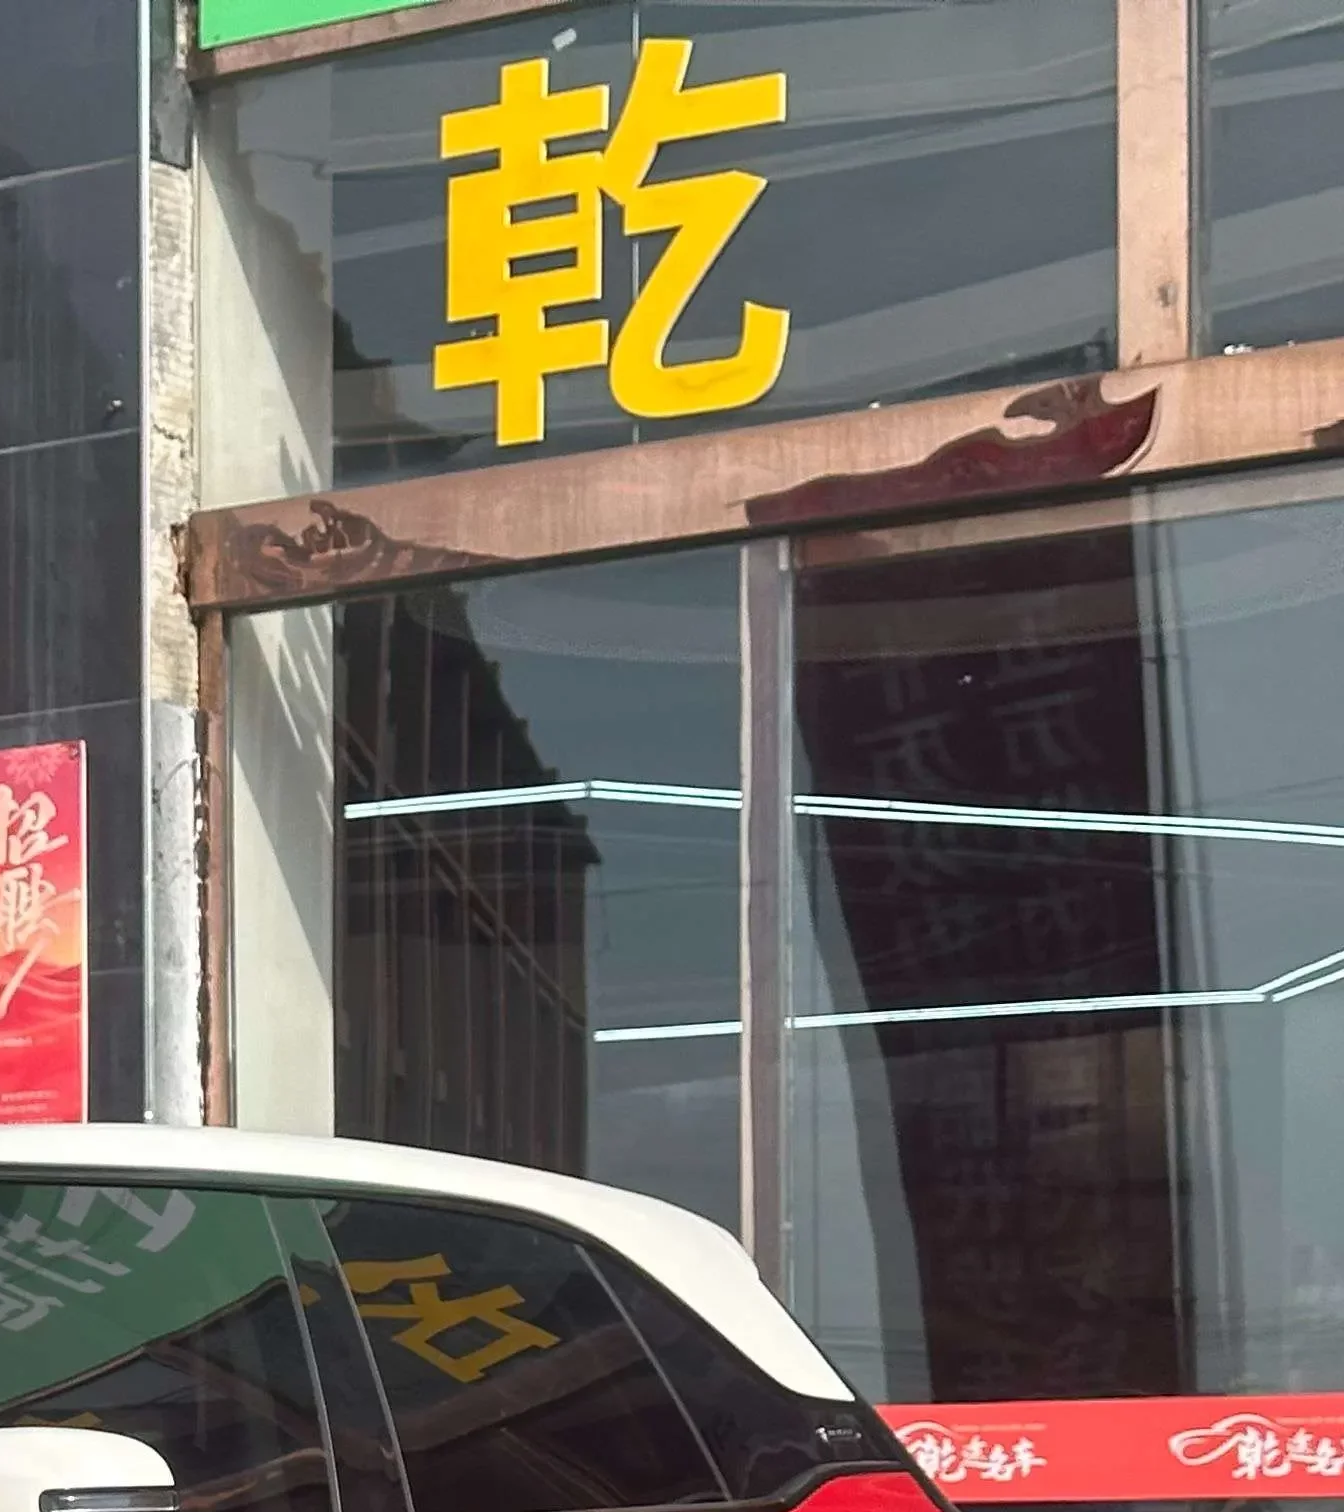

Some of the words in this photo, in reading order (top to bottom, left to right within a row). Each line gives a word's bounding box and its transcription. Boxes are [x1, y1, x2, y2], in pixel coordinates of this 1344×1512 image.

[433, 39, 792, 446] 乾
[1231, 1424, 1344, 1481] 乾途名
